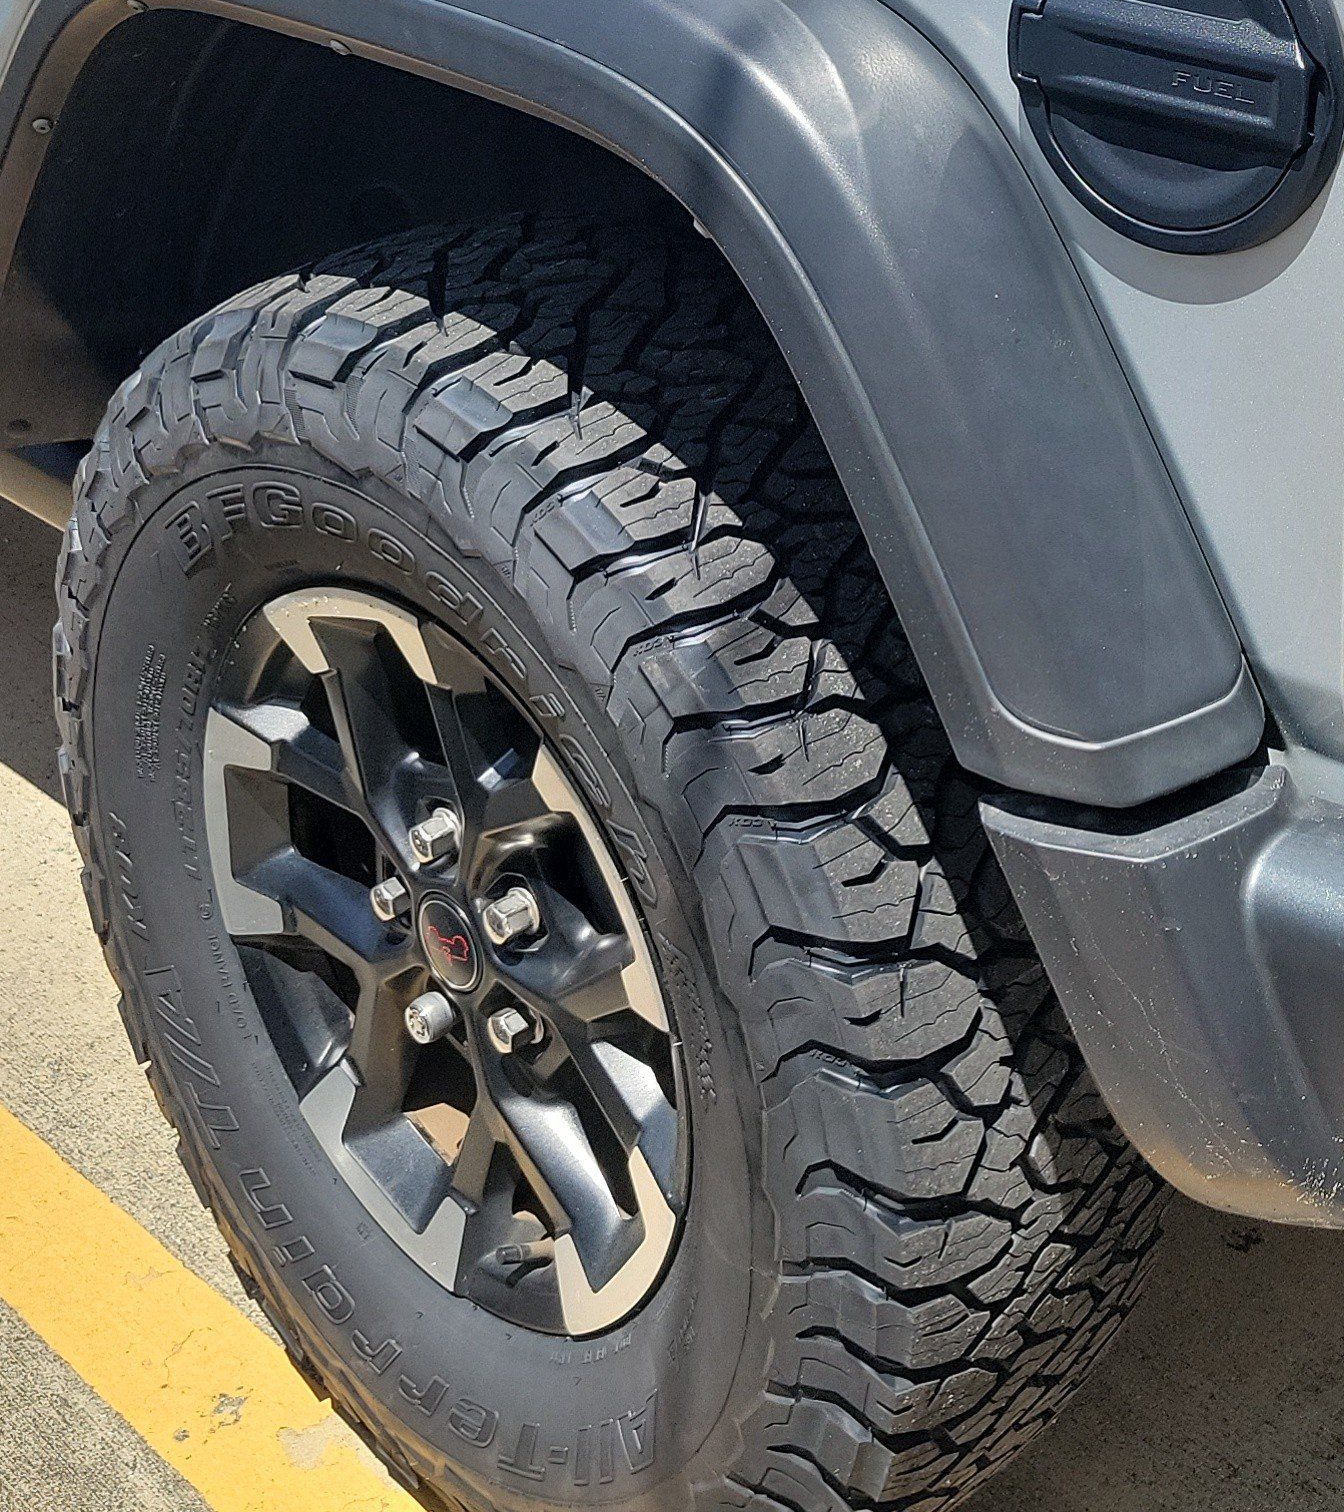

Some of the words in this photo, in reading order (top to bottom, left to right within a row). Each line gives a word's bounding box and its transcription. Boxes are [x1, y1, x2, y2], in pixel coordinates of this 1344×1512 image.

[1171, 71, 1255, 104] FUEL
[165, 479, 662, 912] BFGoodrich
[238, 1165, 659, 1488] All-Terrain
